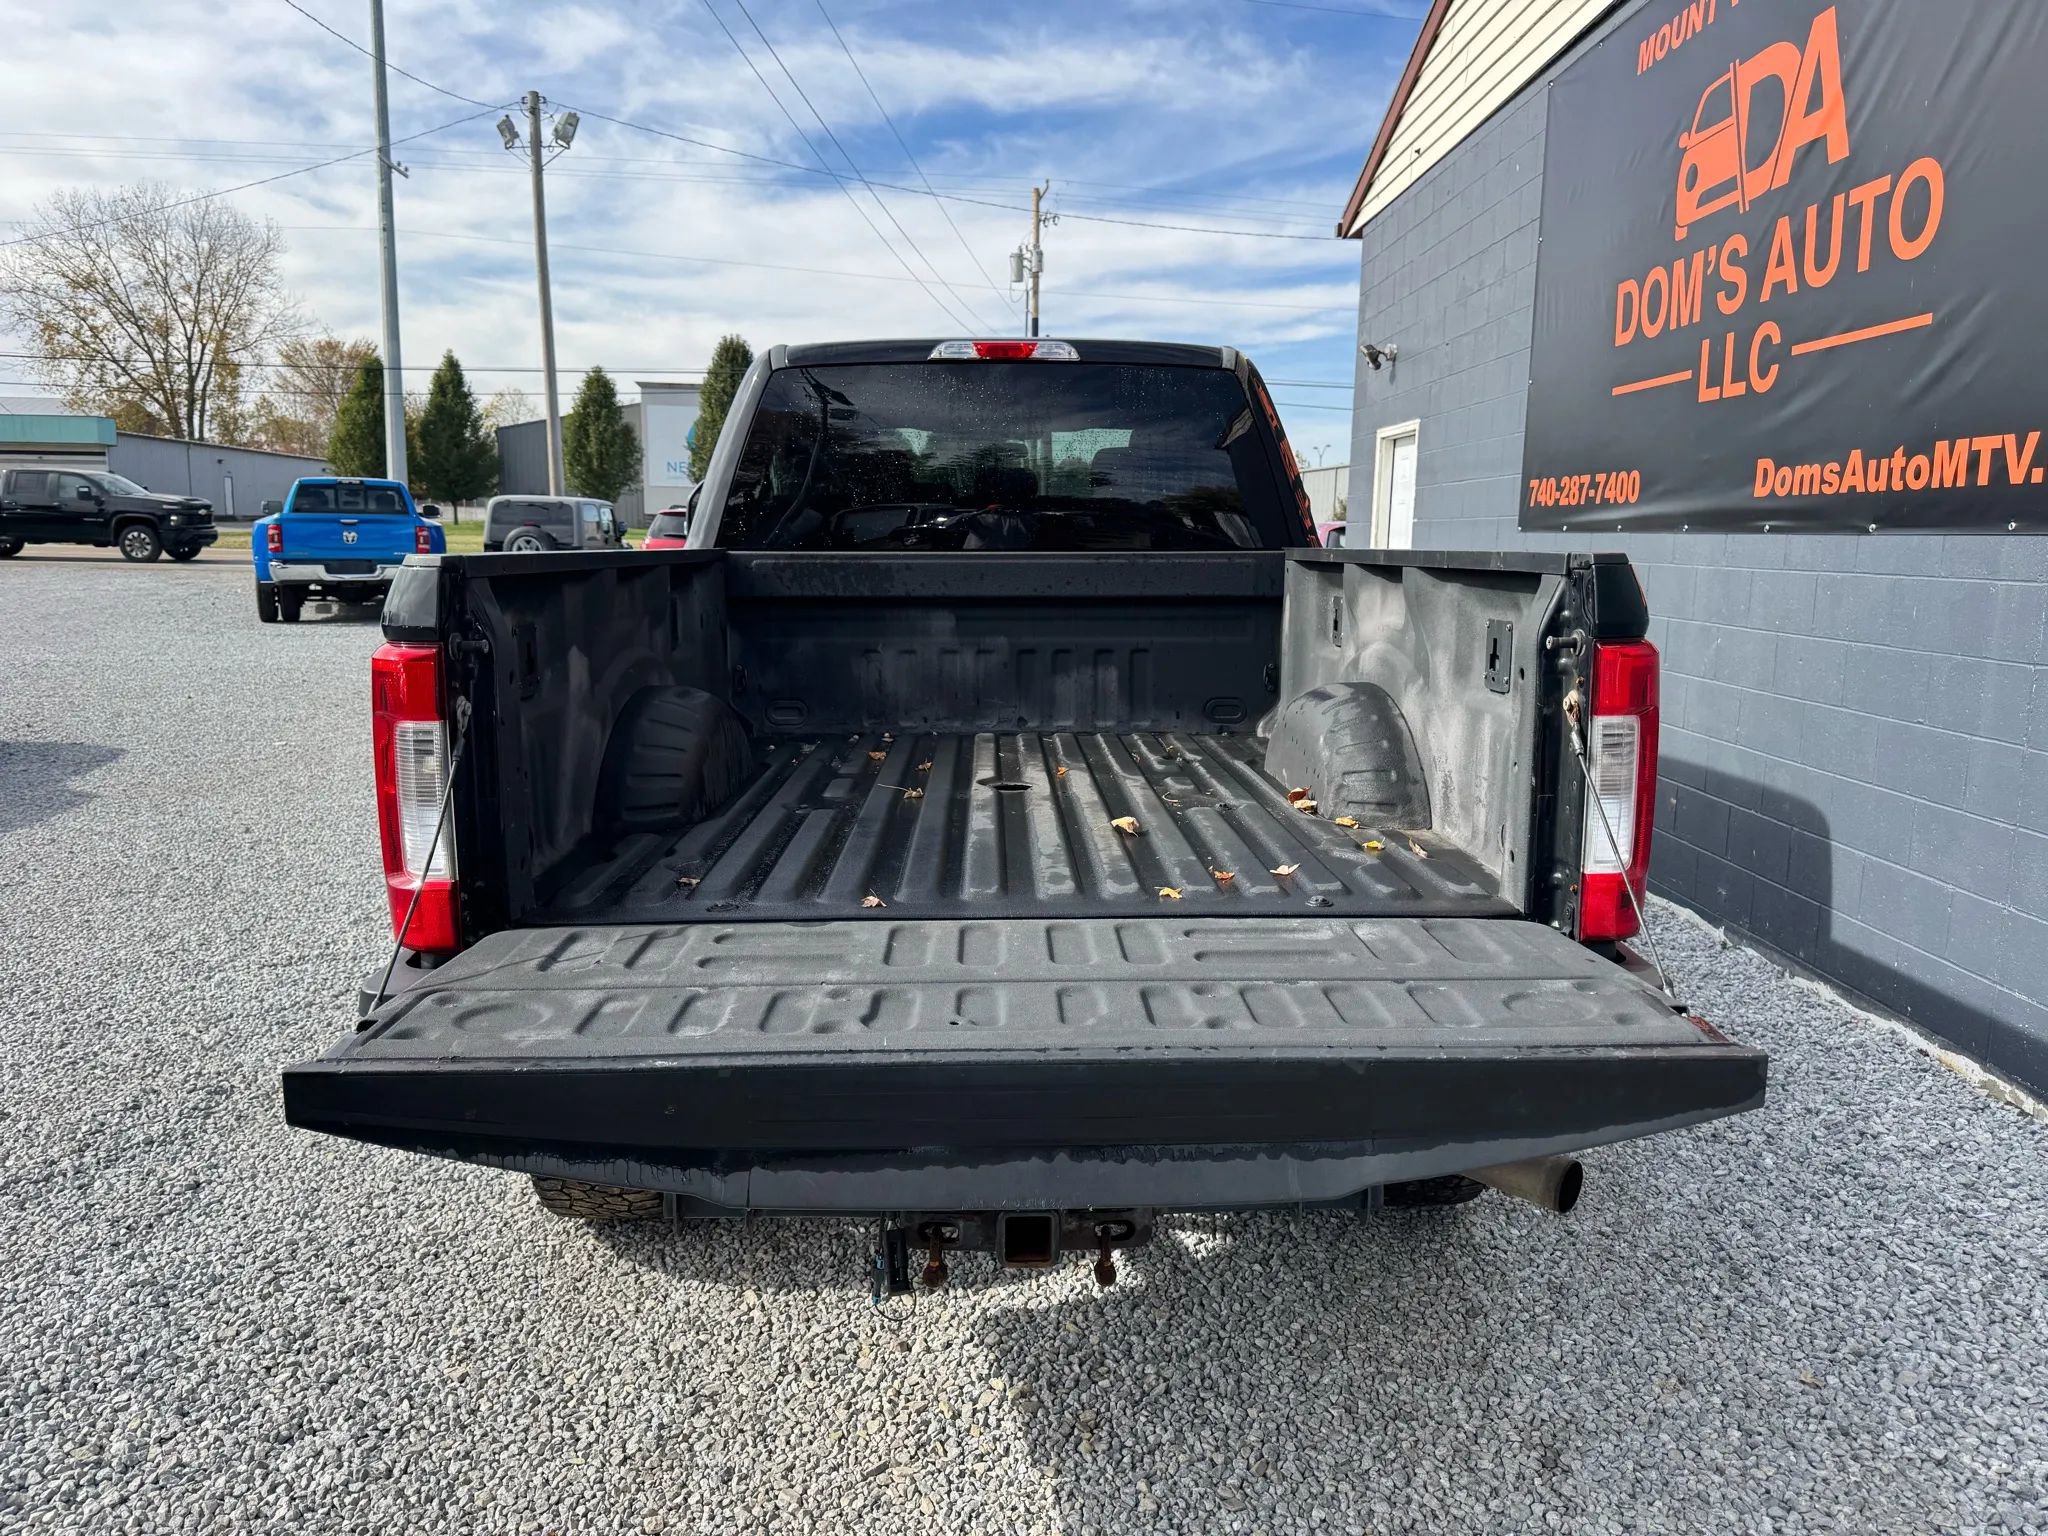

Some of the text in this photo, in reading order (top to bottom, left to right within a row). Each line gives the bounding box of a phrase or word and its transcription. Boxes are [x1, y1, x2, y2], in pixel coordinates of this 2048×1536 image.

[1615, 157, 1944, 347] DOM'S AUTO
[1698, 321, 1781, 403] LLC
[1529, 470, 1641, 507] 740-287-7400
[1753, 431, 2044, 498] DomsAutoMTV.
